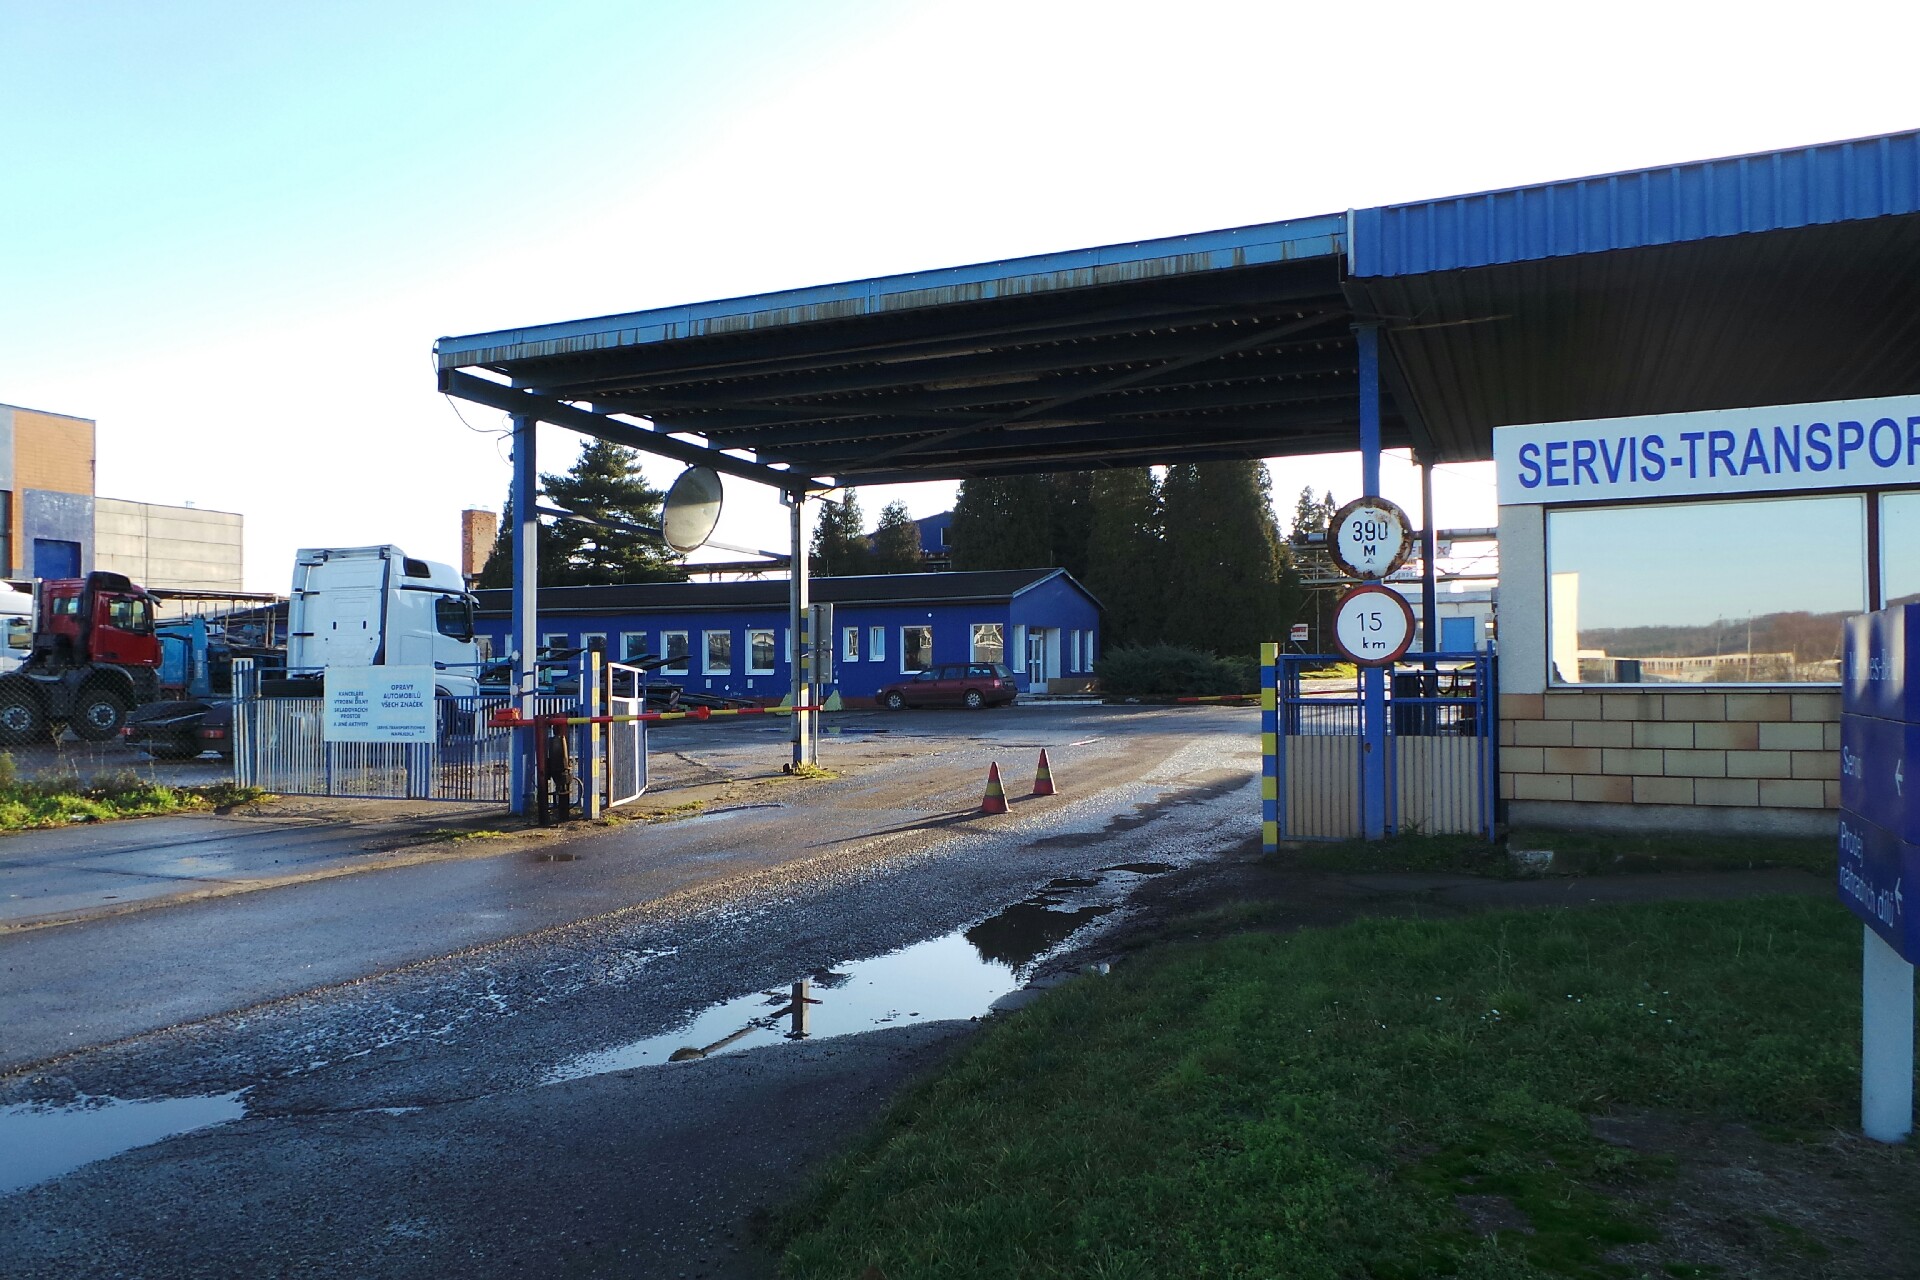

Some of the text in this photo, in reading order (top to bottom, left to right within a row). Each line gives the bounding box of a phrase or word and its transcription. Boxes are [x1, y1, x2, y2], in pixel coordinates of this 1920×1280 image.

[1352, 520, 1388, 544] 3,90
[1364, 545, 1376, 557] M
[1356, 612, 1383, 632] 15
[1362, 637, 1386, 649] km
[383, 691, 421, 699] AUTOMOBILŮ
[381, 700, 423, 708] VŠECH ZNAČEK
[1841, 820, 1863, 867] Prodej
